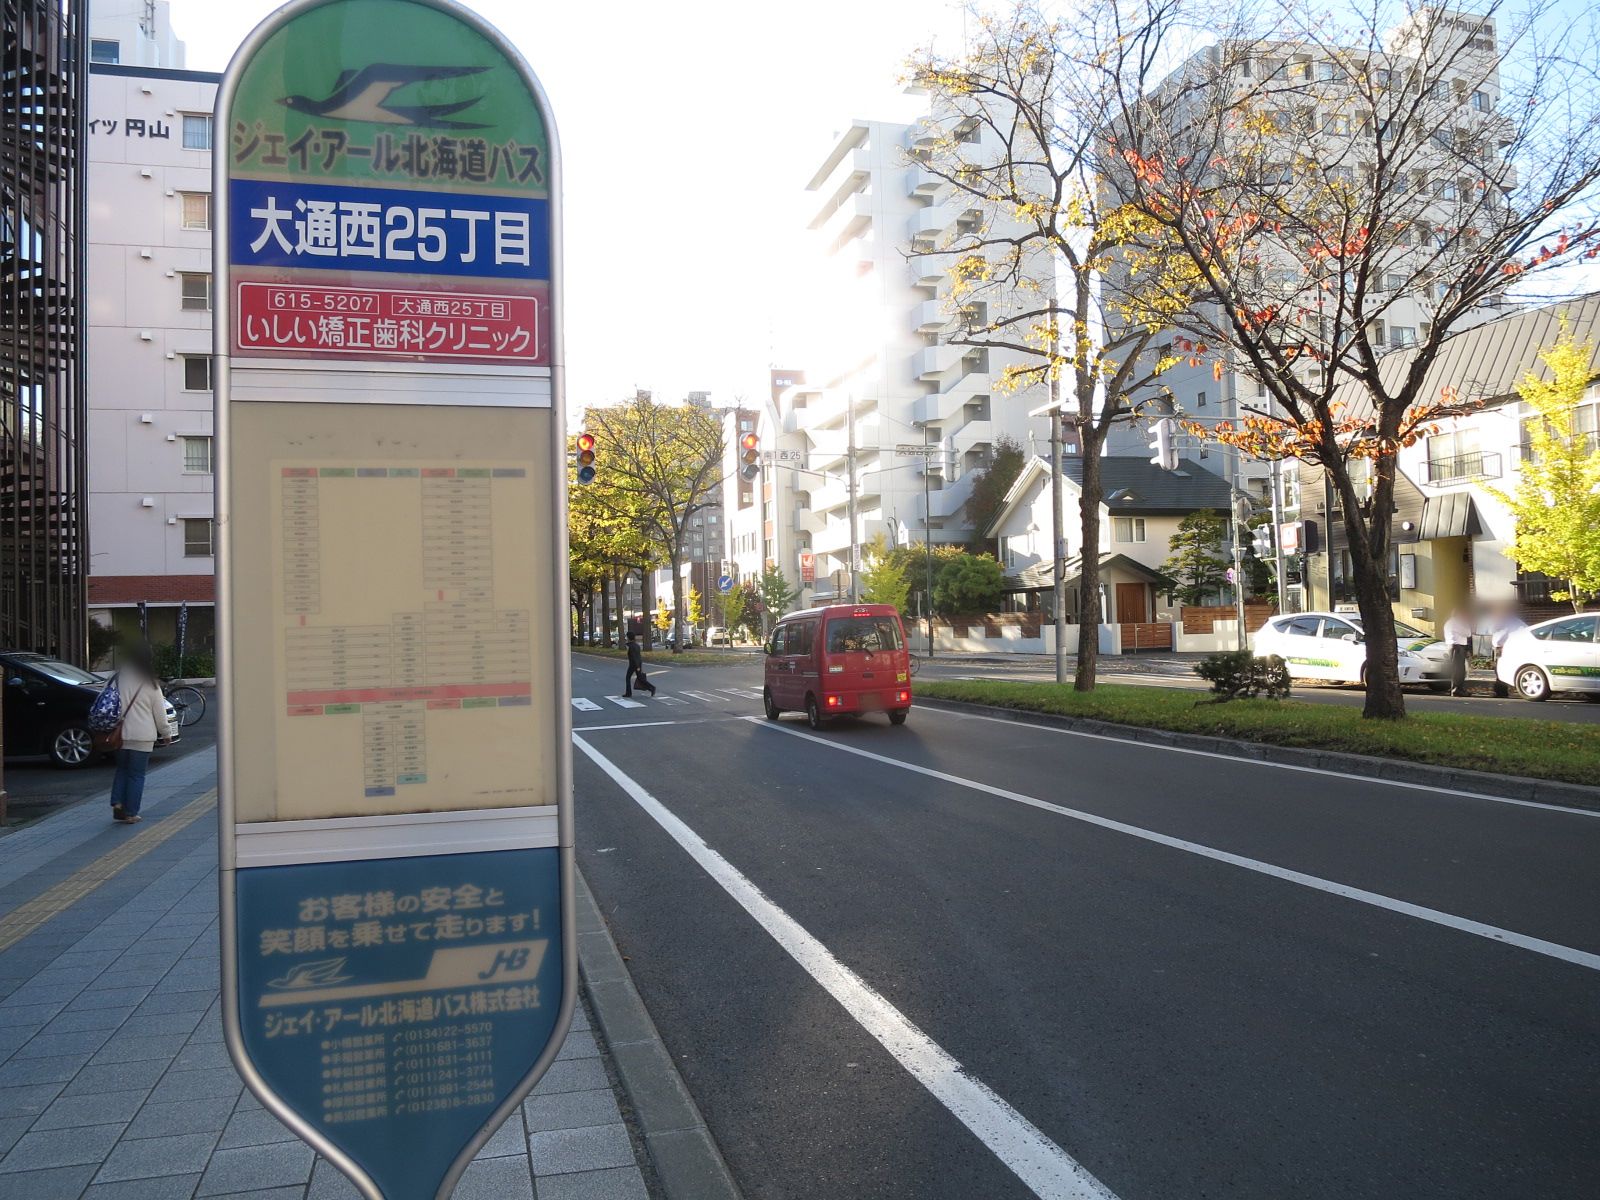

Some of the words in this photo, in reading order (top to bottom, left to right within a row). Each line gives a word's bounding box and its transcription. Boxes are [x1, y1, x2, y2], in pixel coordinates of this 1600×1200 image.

[233, 120, 544, 185] ジェイ・アール北海道バス
[249, 196, 531, 266] 大通西25丁目
[273, 293, 373, 312] 615-5207
[398, 299, 506, 318] 大通西25丁目
[246, 314, 531, 353] いしい矯正歯科クリニック
[298, 883, 505, 922] お客様の安全と
[259, 908, 541, 956] 笑顔を乗せて走ります!
[264, 984, 541, 1039] ジェイ・アール北海道バス株式会社
